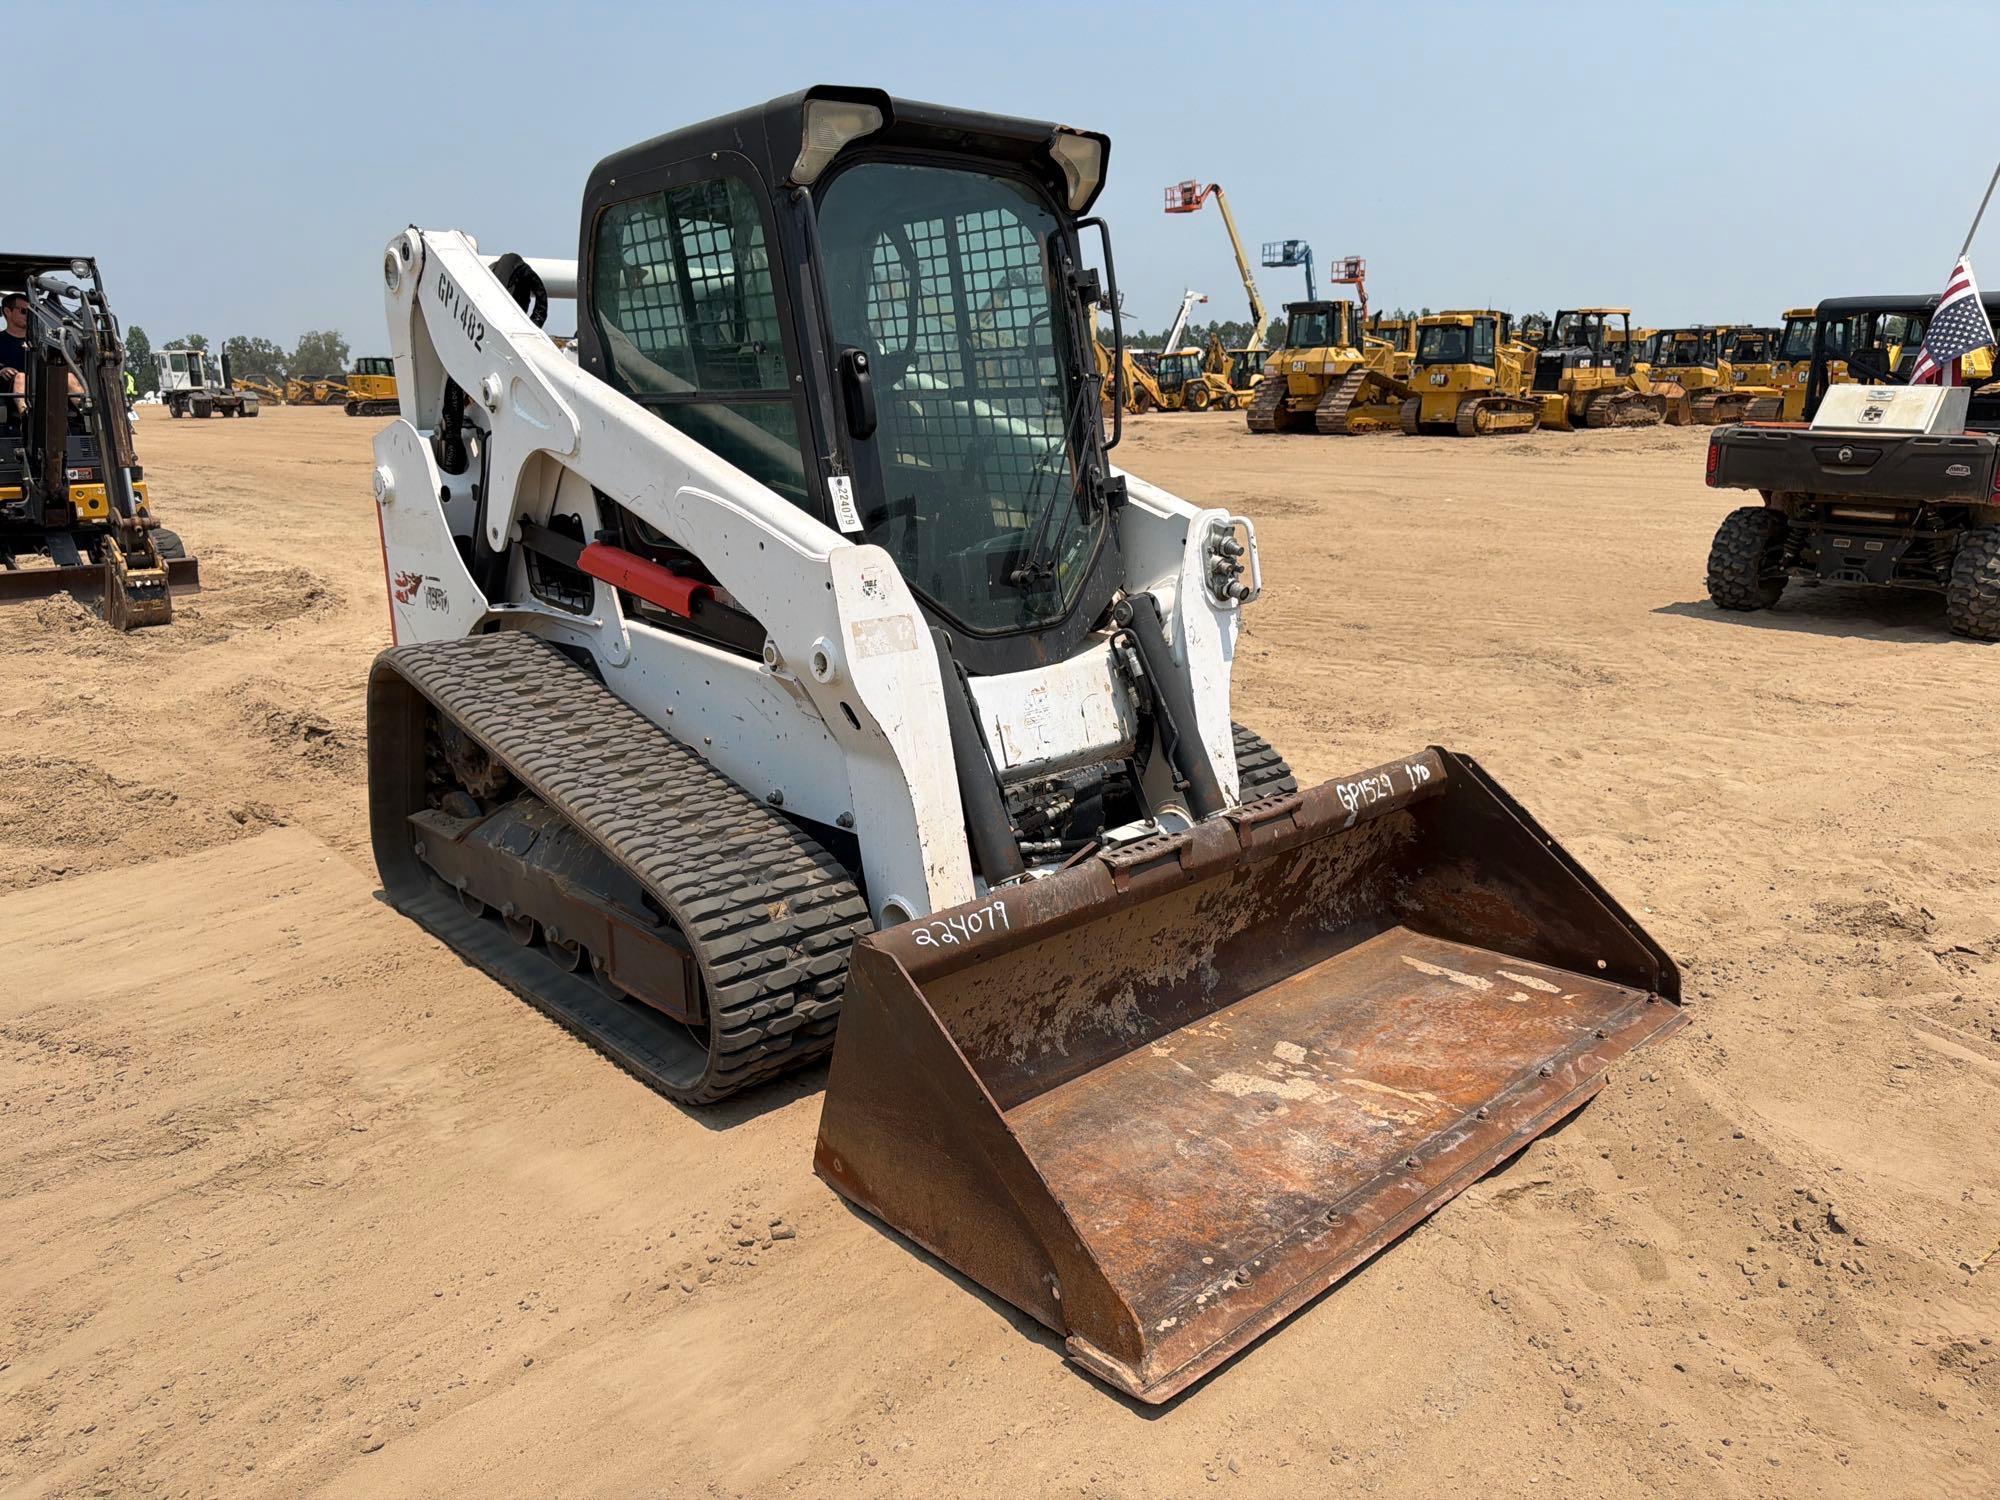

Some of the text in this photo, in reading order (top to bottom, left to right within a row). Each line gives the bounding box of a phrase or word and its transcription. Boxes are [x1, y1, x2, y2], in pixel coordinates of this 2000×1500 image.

[1292, 361, 1306, 373] CAT
[1579, 359, 1591, 369] CAT
[1430, 374, 1446, 385] CAT
[837, 487, 856, 526] 224079
[1336, 772, 1395, 812] GP1529
[911, 900, 1010, 947] 224079
